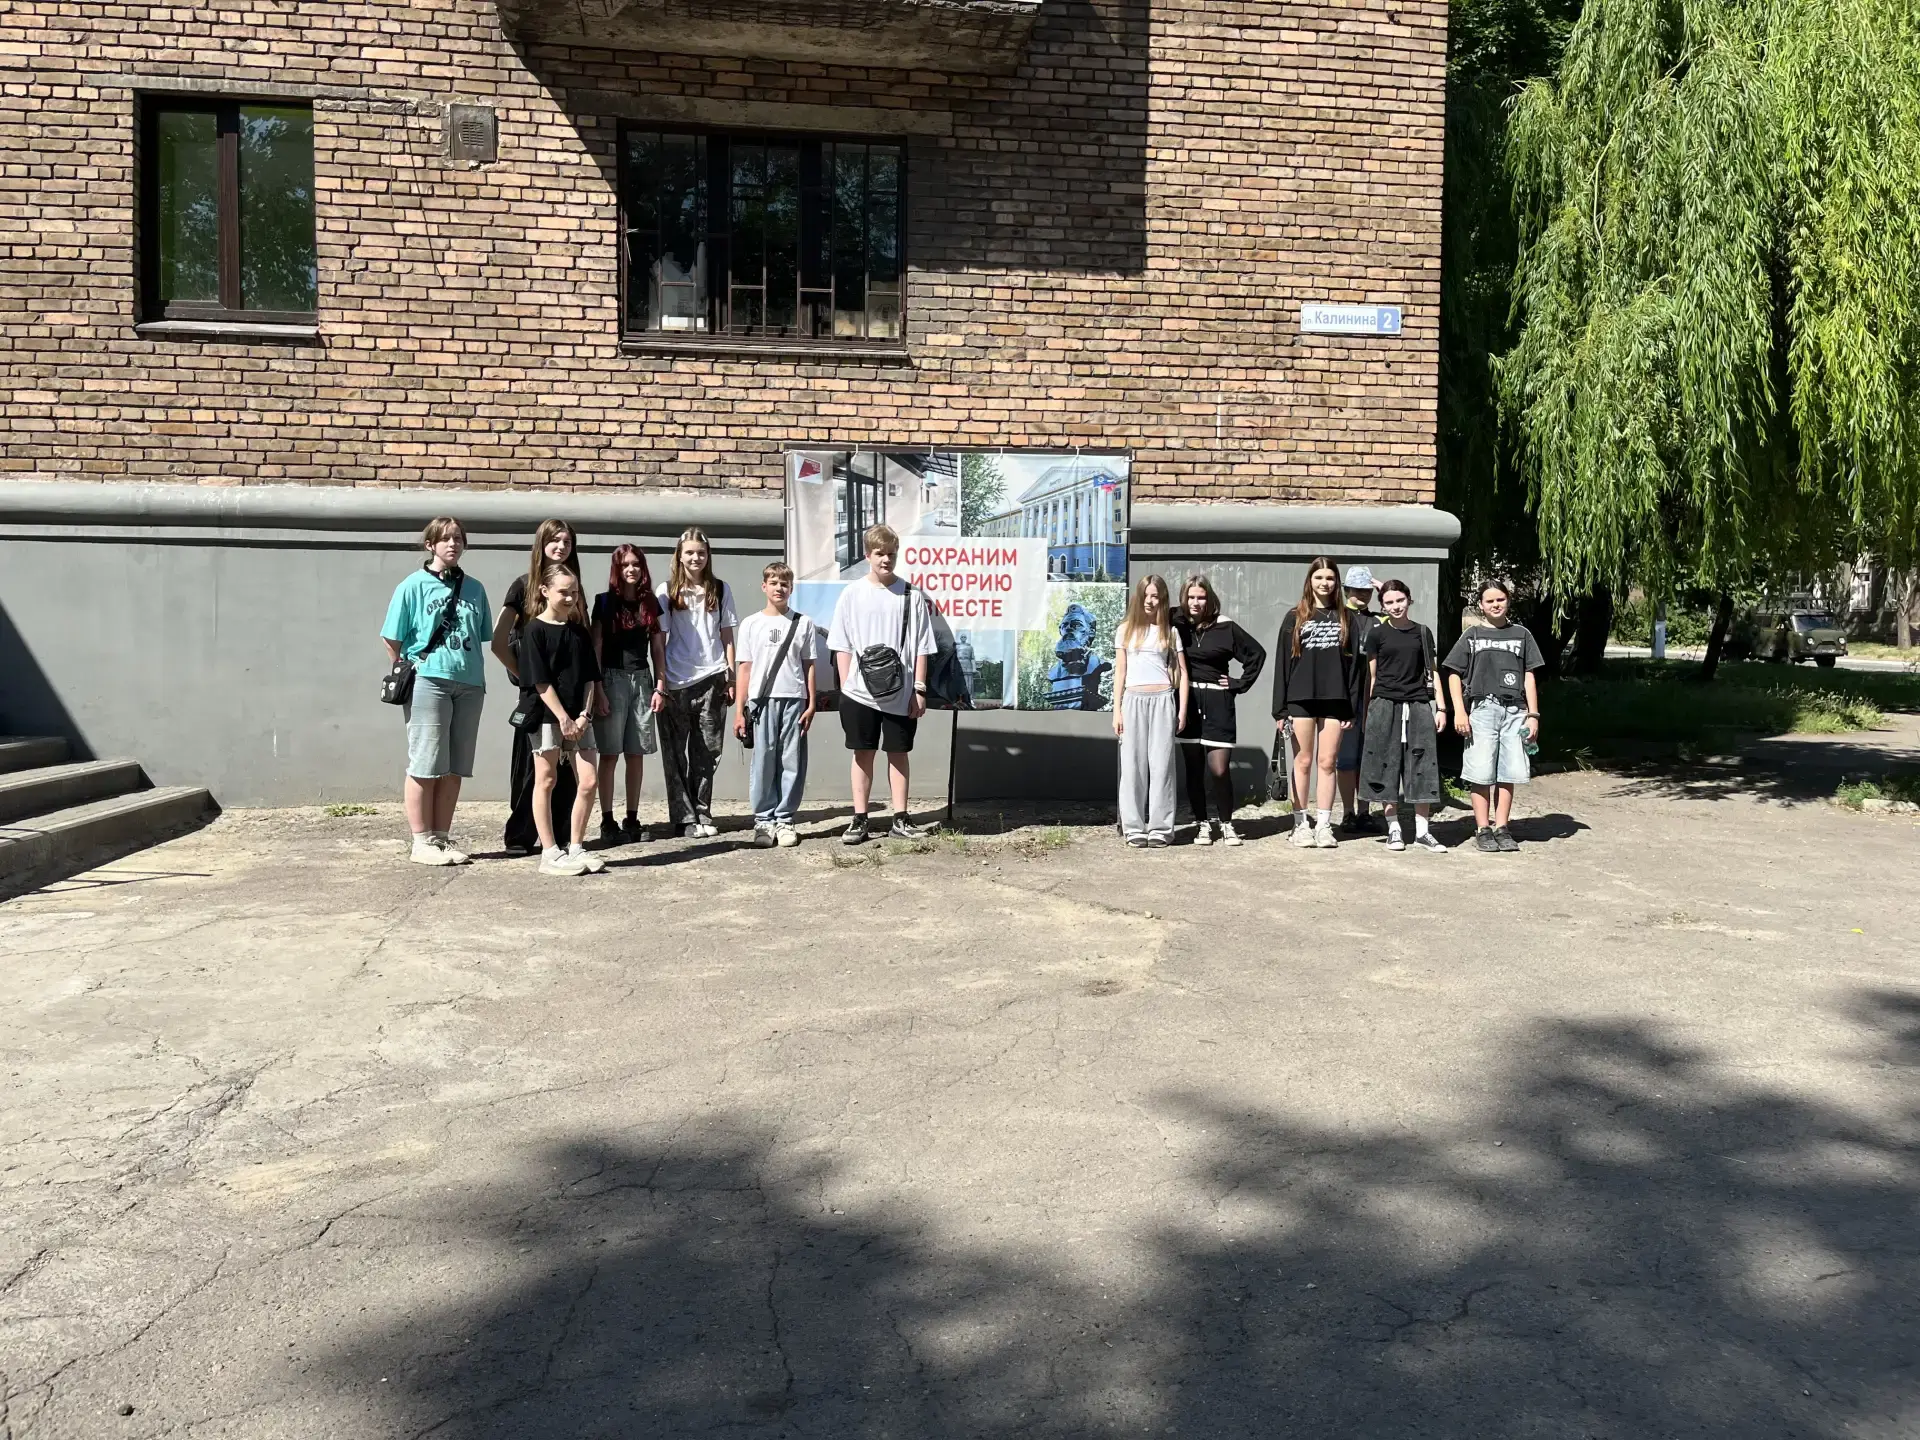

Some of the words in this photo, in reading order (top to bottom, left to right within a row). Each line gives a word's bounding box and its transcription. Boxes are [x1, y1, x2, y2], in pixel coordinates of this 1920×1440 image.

[1315, 311, 1376, 325] Калинина
[1383, 312, 1392, 329] 2
[905, 547, 1017, 566] СОХРАНИМ
[911, 573, 1012, 591] ИСТОРИЮ
